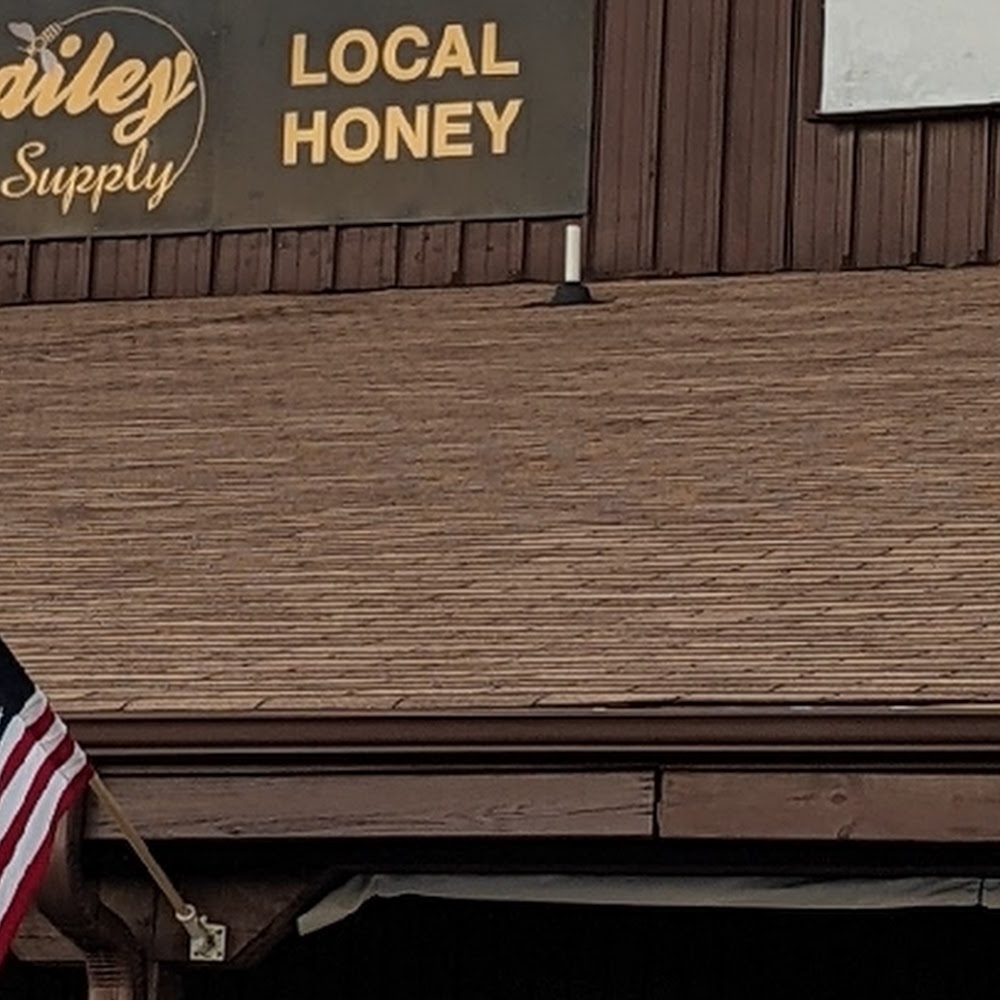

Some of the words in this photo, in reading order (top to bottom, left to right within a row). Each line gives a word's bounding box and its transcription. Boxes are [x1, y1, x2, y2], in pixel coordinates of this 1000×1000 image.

[289, 22, 520, 88] LOCAL
[281, 98, 523, 166] HONEY
[0, 139, 179, 214] Supply
